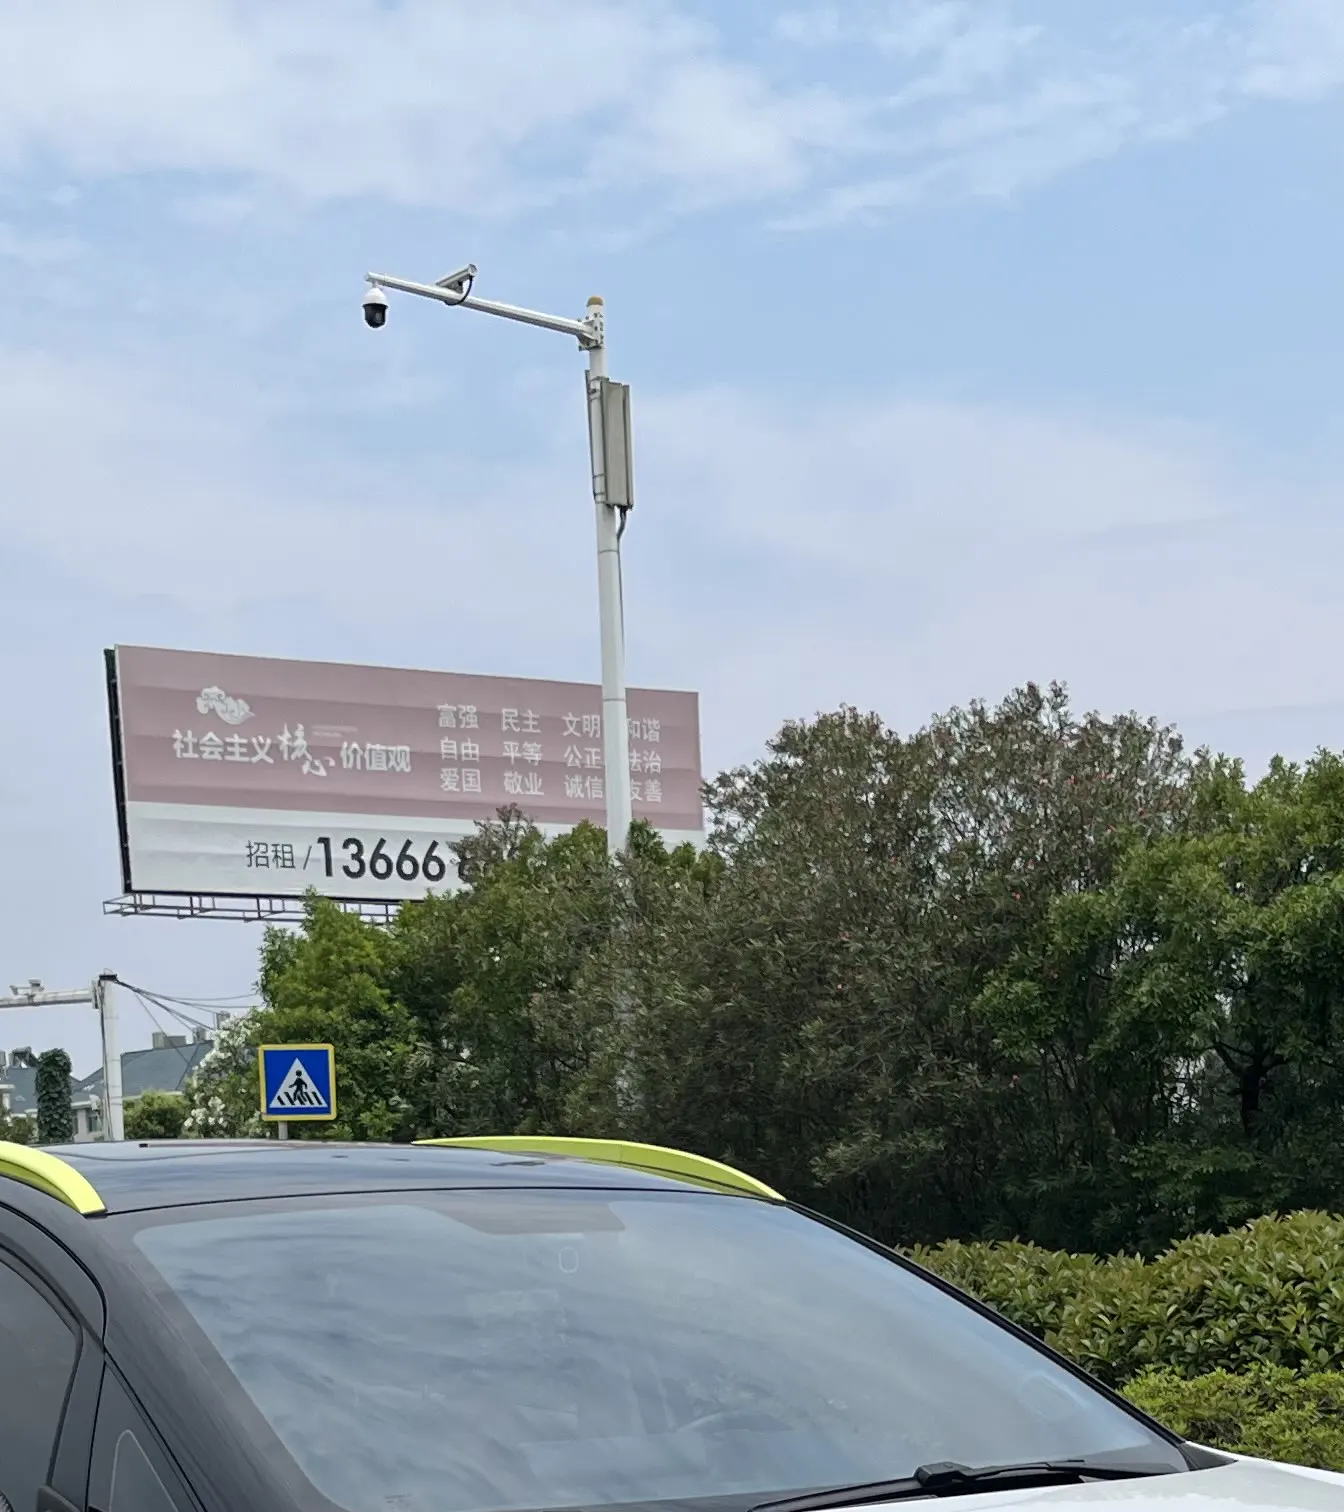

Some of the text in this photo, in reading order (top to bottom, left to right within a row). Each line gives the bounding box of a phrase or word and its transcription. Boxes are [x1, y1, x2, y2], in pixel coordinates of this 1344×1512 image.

[437, 703, 661, 742] 富强 民主 文明 和谐
[172, 723, 412, 777] 社会主义核心价值观
[440, 736, 480, 762] 自由
[502, 741, 543, 766] 平等
[563, 745, 602, 770] 公正
[440, 767, 482, 793] 爱国
[503, 771, 544, 796] 敬业
[564, 775, 603, 799] 诚信
[246, 840, 296, 869] 招租
